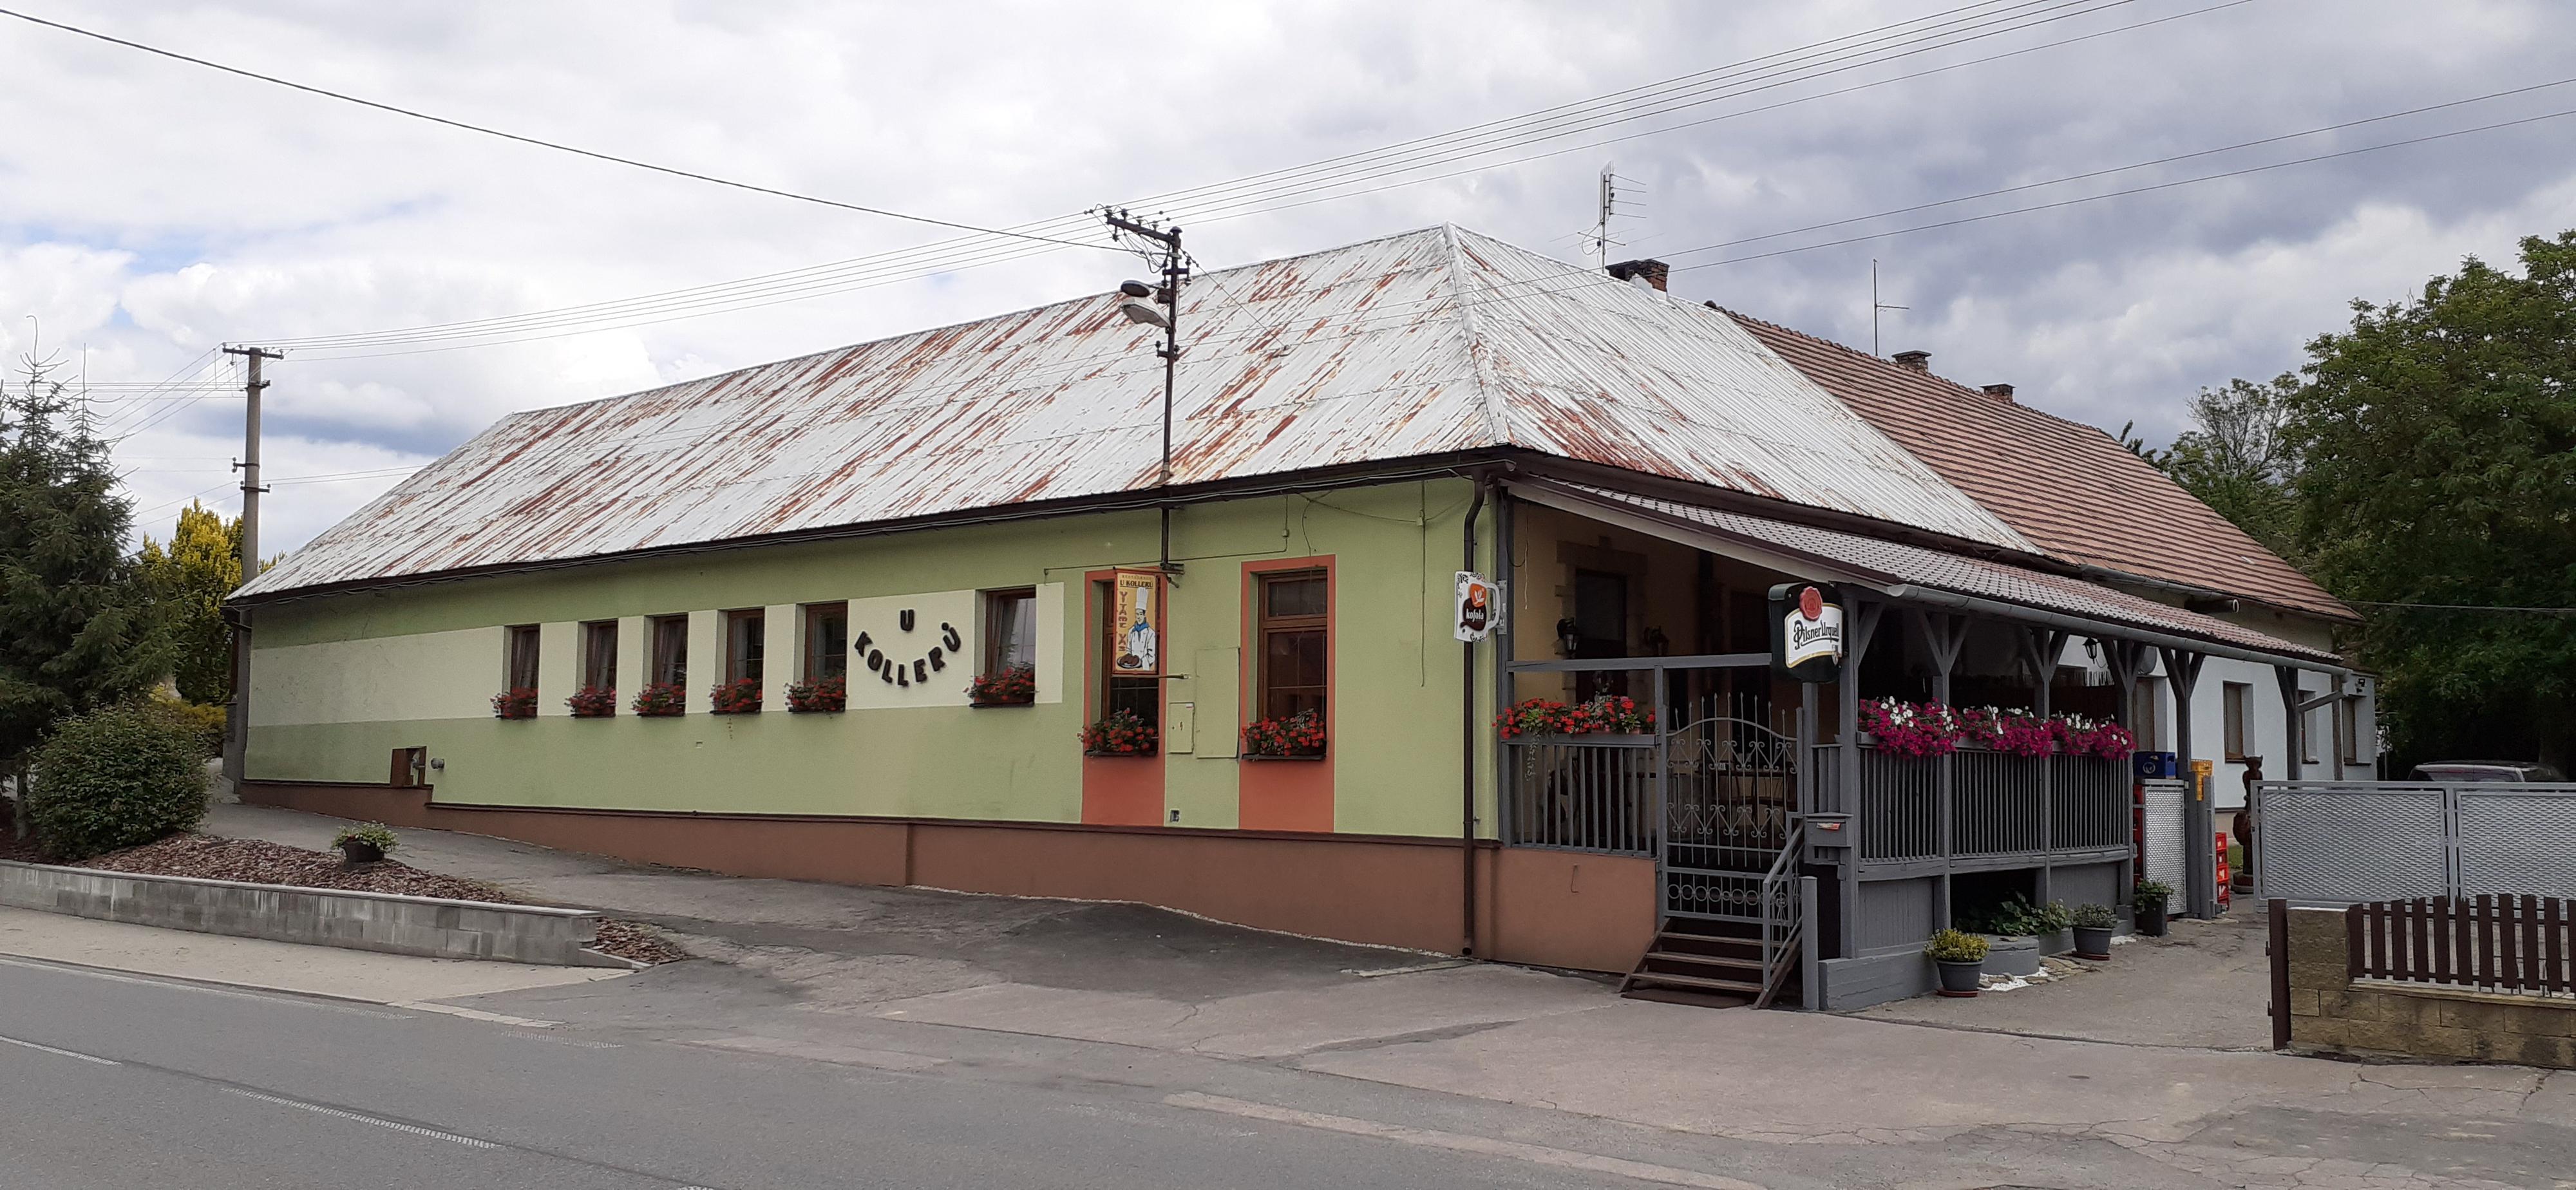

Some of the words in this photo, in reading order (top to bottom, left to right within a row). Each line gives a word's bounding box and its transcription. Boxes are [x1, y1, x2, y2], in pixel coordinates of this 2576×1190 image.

[900, 609, 915, 632] U
[1466, 608, 1484, 623] kofola
[1794, 619, 1821, 650] Pilsner
[1821, 619, 1839, 643] Urquell
[854, 622, 961, 686] KOLLERŮ
